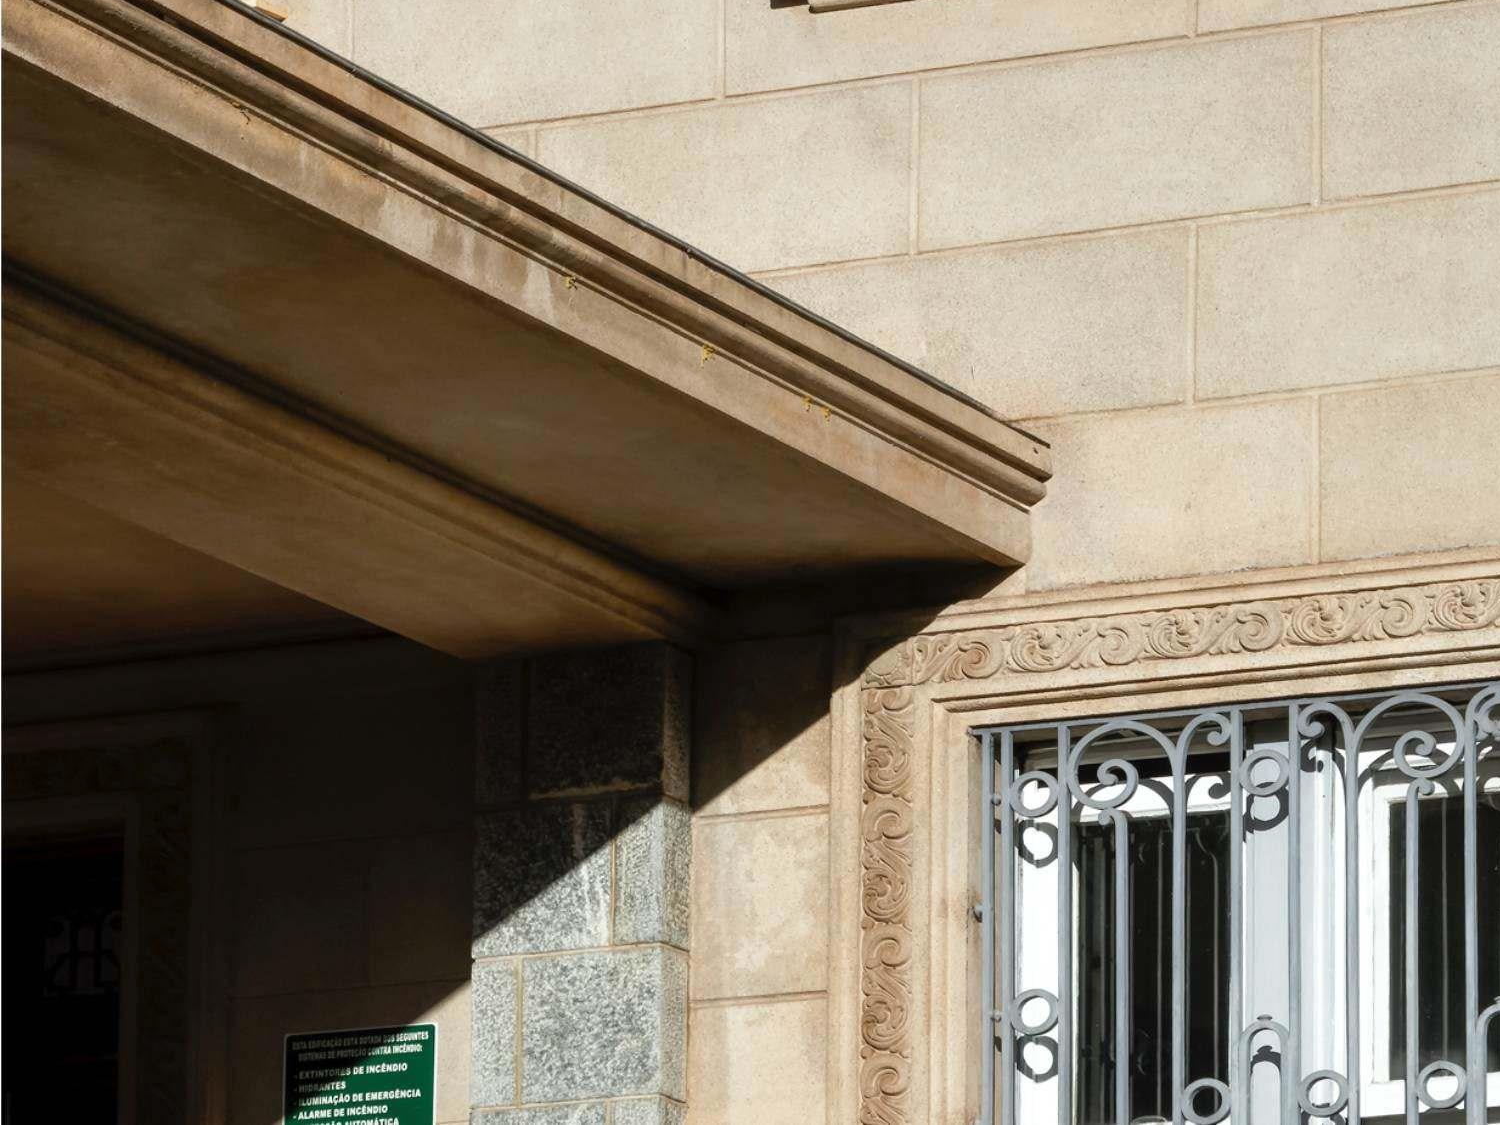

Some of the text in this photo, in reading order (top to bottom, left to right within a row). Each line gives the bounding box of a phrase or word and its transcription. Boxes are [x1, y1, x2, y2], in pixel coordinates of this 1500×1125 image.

[395, 1031, 429, 1042] SEGUINTES
[328, 1050, 336, 1059] DE
[368, 1045, 392, 1056] CONTRA
[299, 1062, 408, 1080] EXTINTORES DE INCÊNDIO
[299, 1081, 347, 1093] HIDRANTES
[298, 1088, 422, 1107] ILUMINAÇÃO DE EMERGÊNCIA
[298, 1105, 389, 1121] ALARME DE INCÊNDIO
